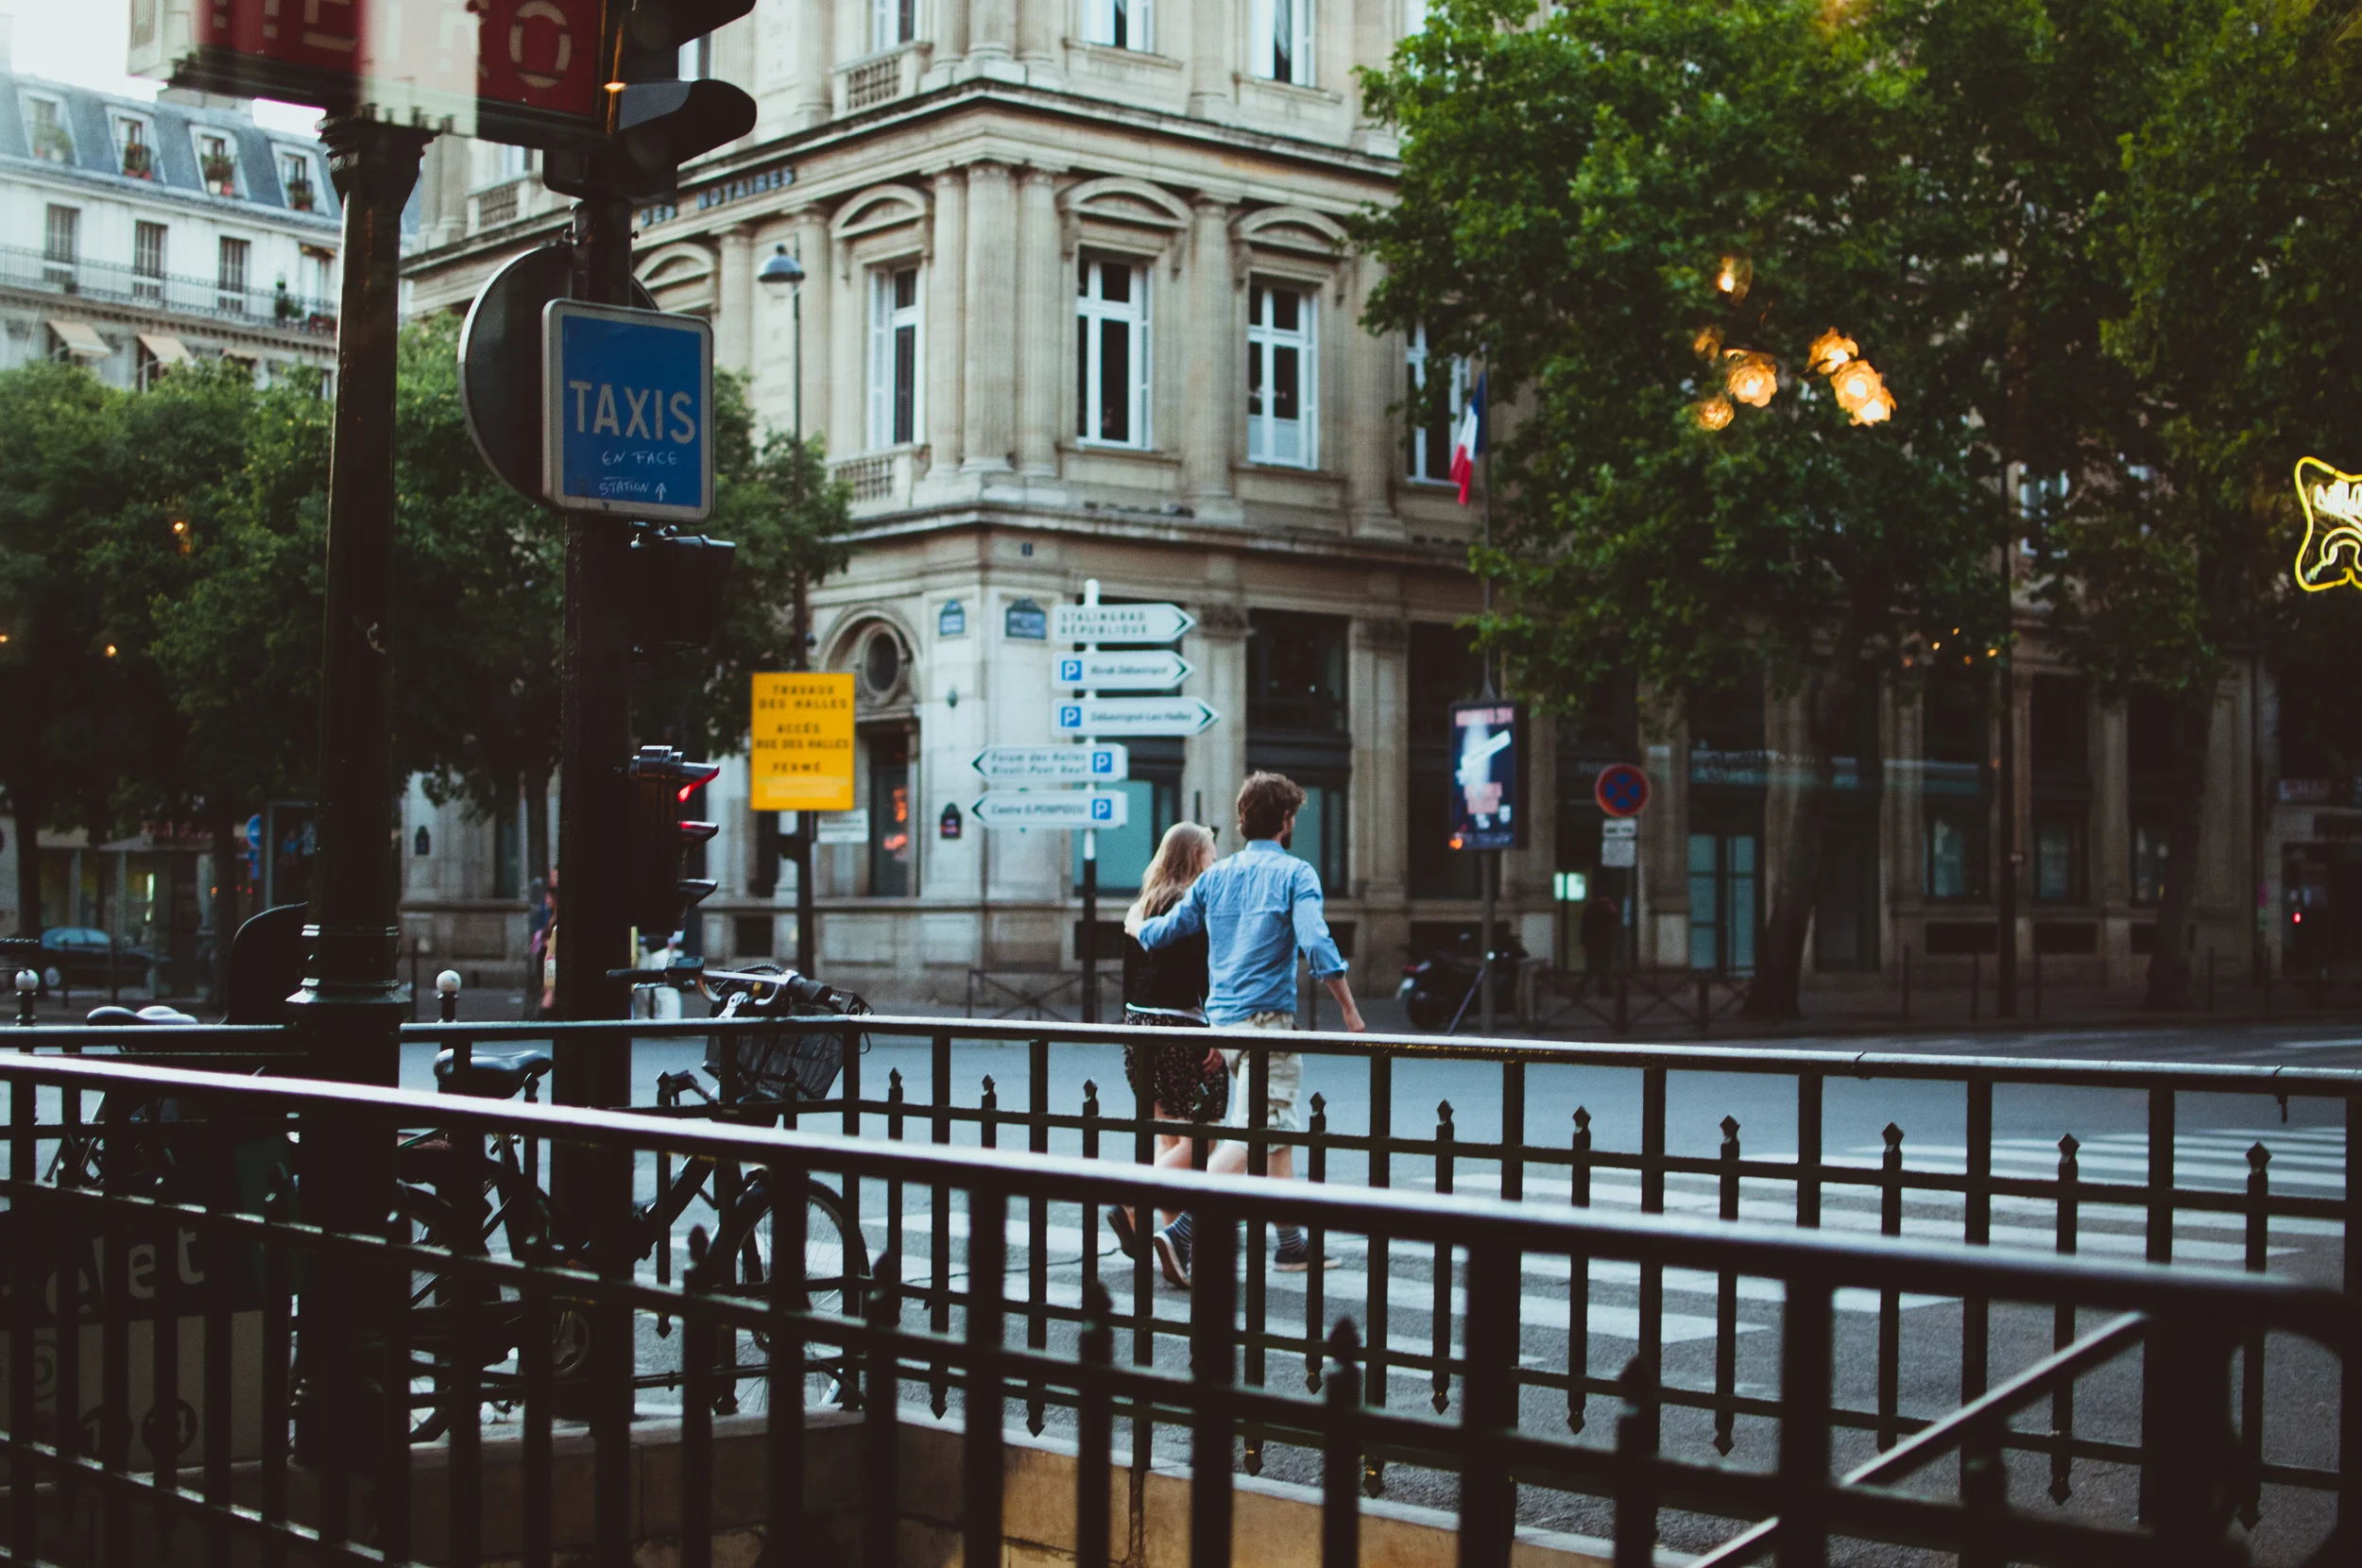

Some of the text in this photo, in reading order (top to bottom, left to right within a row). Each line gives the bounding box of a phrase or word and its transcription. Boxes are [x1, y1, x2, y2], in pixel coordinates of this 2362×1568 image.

[695, 164, 796, 212] NOTAIRES
[569, 380, 695, 445] TAXIS
[602, 451, 678, 466] EN FACE
[599, 481, 650, 496] STATION
[1061, 612, 1146, 622] STALINGRAD
[773, 685, 834, 696] TRAVAUX
[759, 698, 847, 710] DES HALLES
[756, 738, 848, 749] RUE DES HALLES
